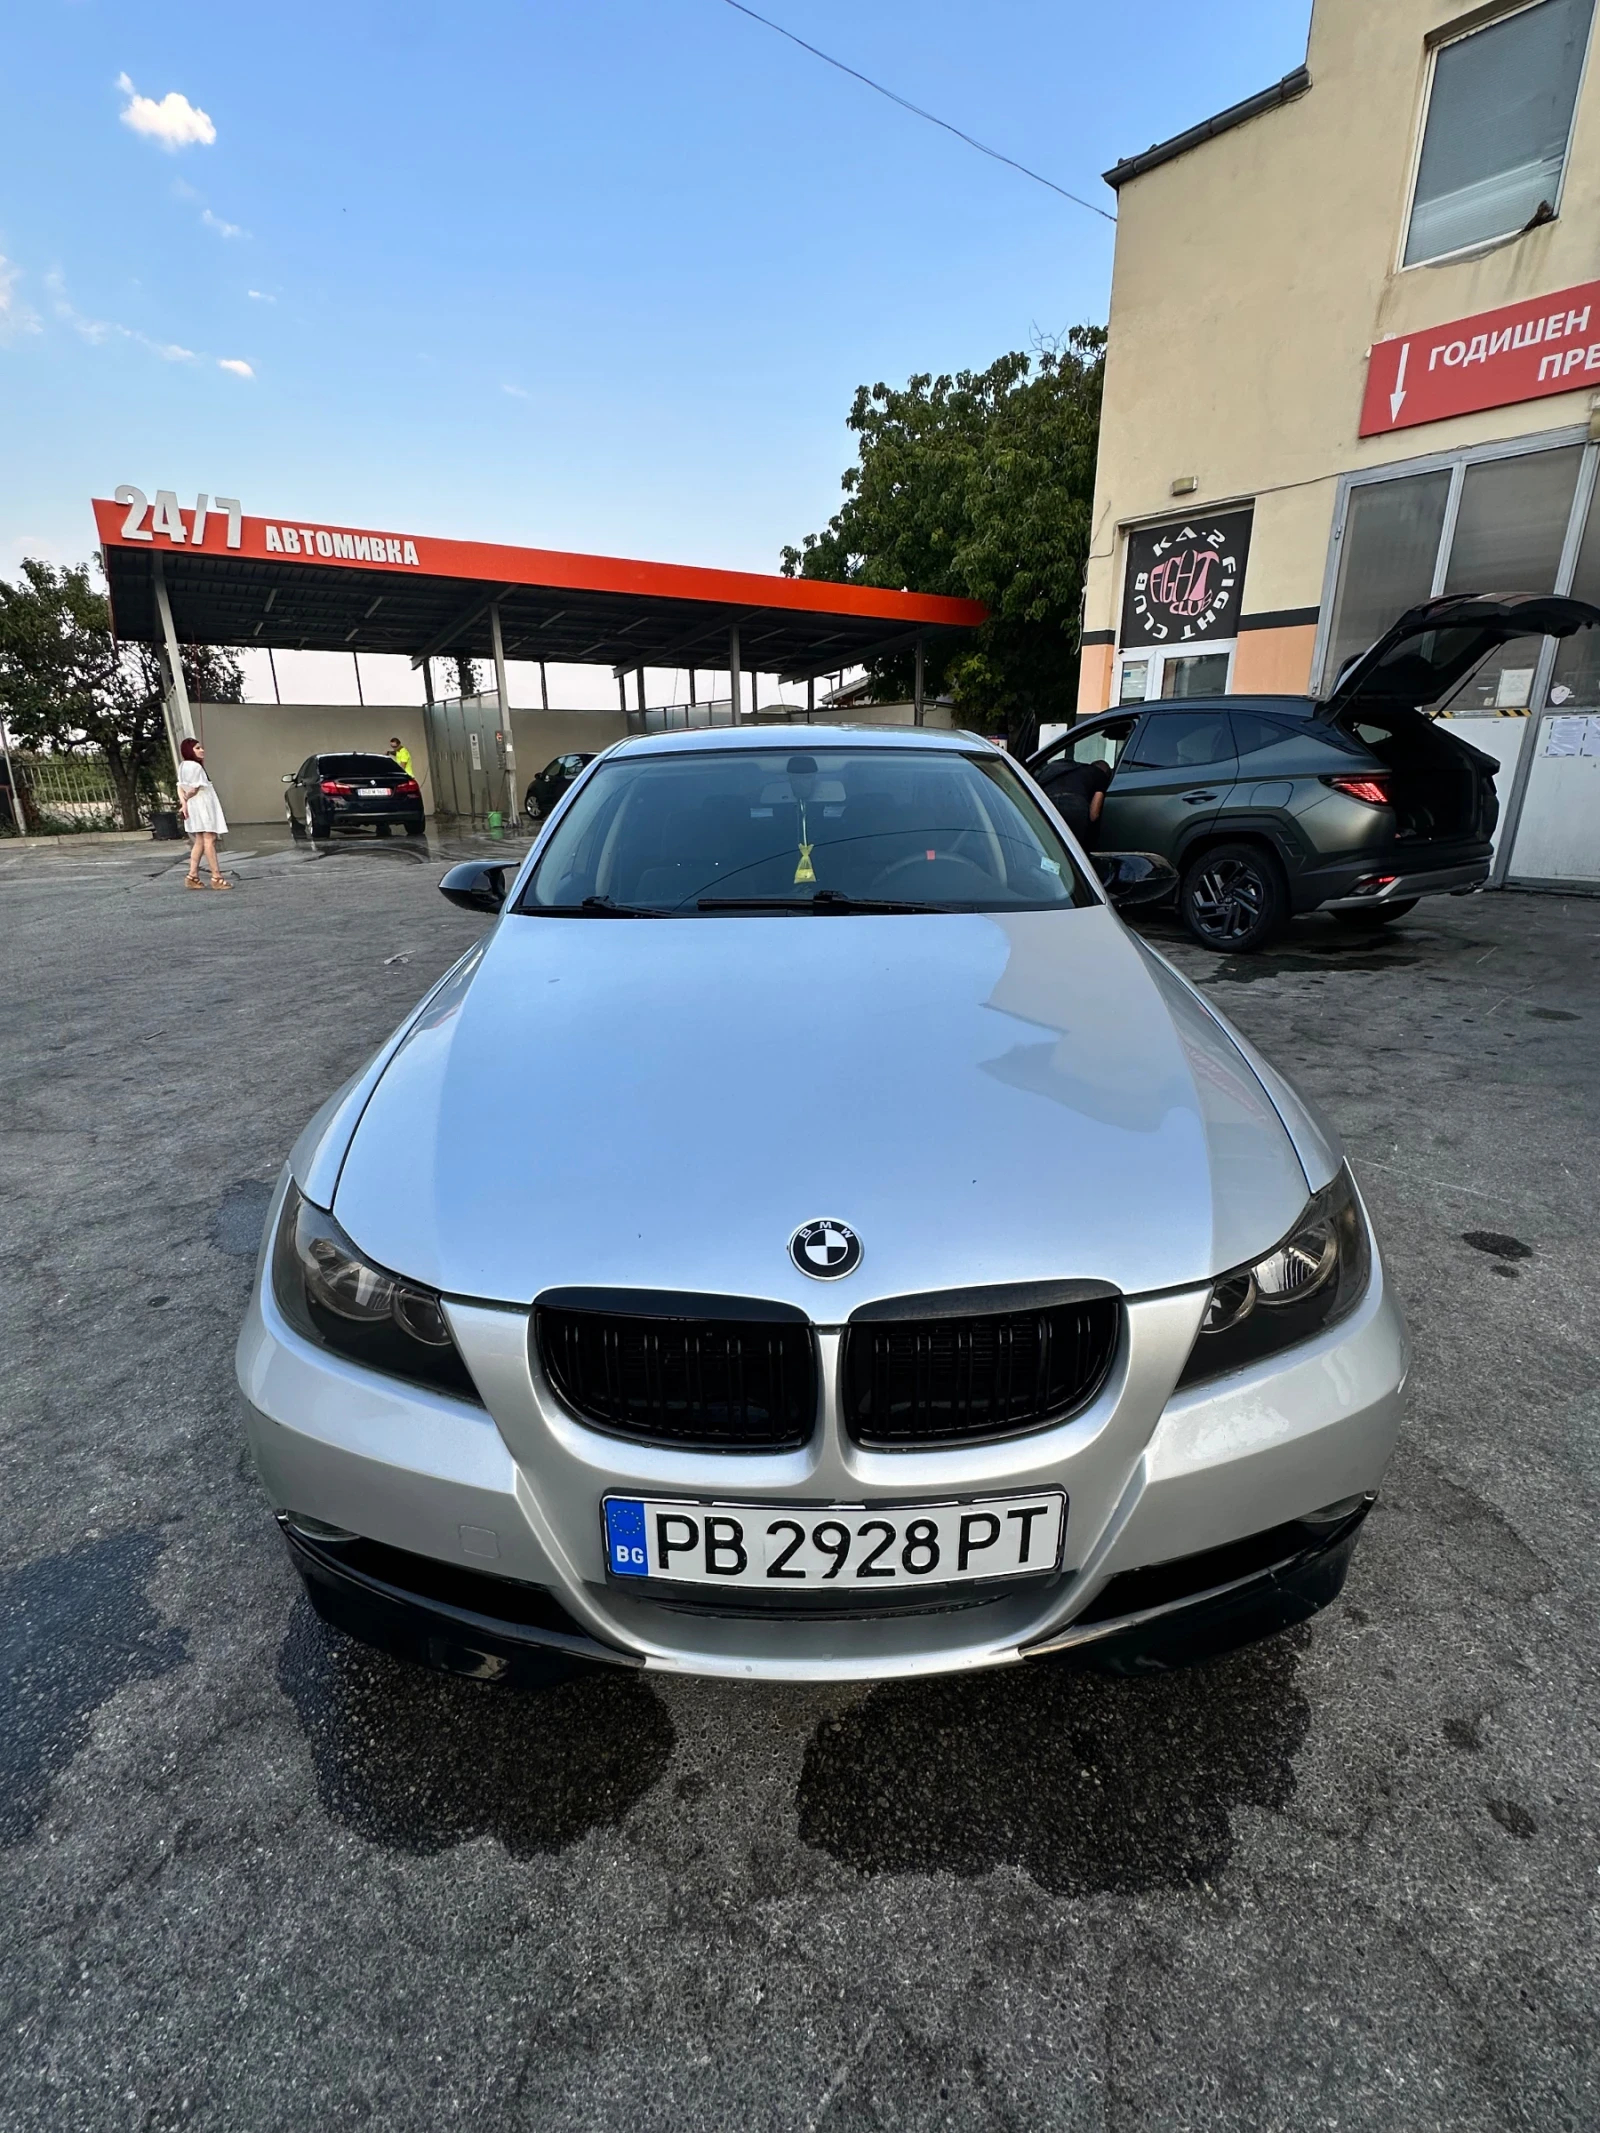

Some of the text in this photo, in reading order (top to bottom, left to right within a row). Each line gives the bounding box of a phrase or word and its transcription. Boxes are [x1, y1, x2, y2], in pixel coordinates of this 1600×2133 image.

[1428, 305, 1591, 371] ГОДИШЕН
[114, 484, 420, 566] 24/7 АВТОМИВКА
[1134, 572, 1169, 639] CLUB
[1150, 549, 1220, 603] FIGHT
[1169, 589, 1213, 616] CLUB
[1180, 556, 1236, 640] FIGHT
[799, 1221, 854, 1239] BMW
[616, 1545, 644, 1564] BG
[656, 1505, 1048, 1579] PB 2928 PT
